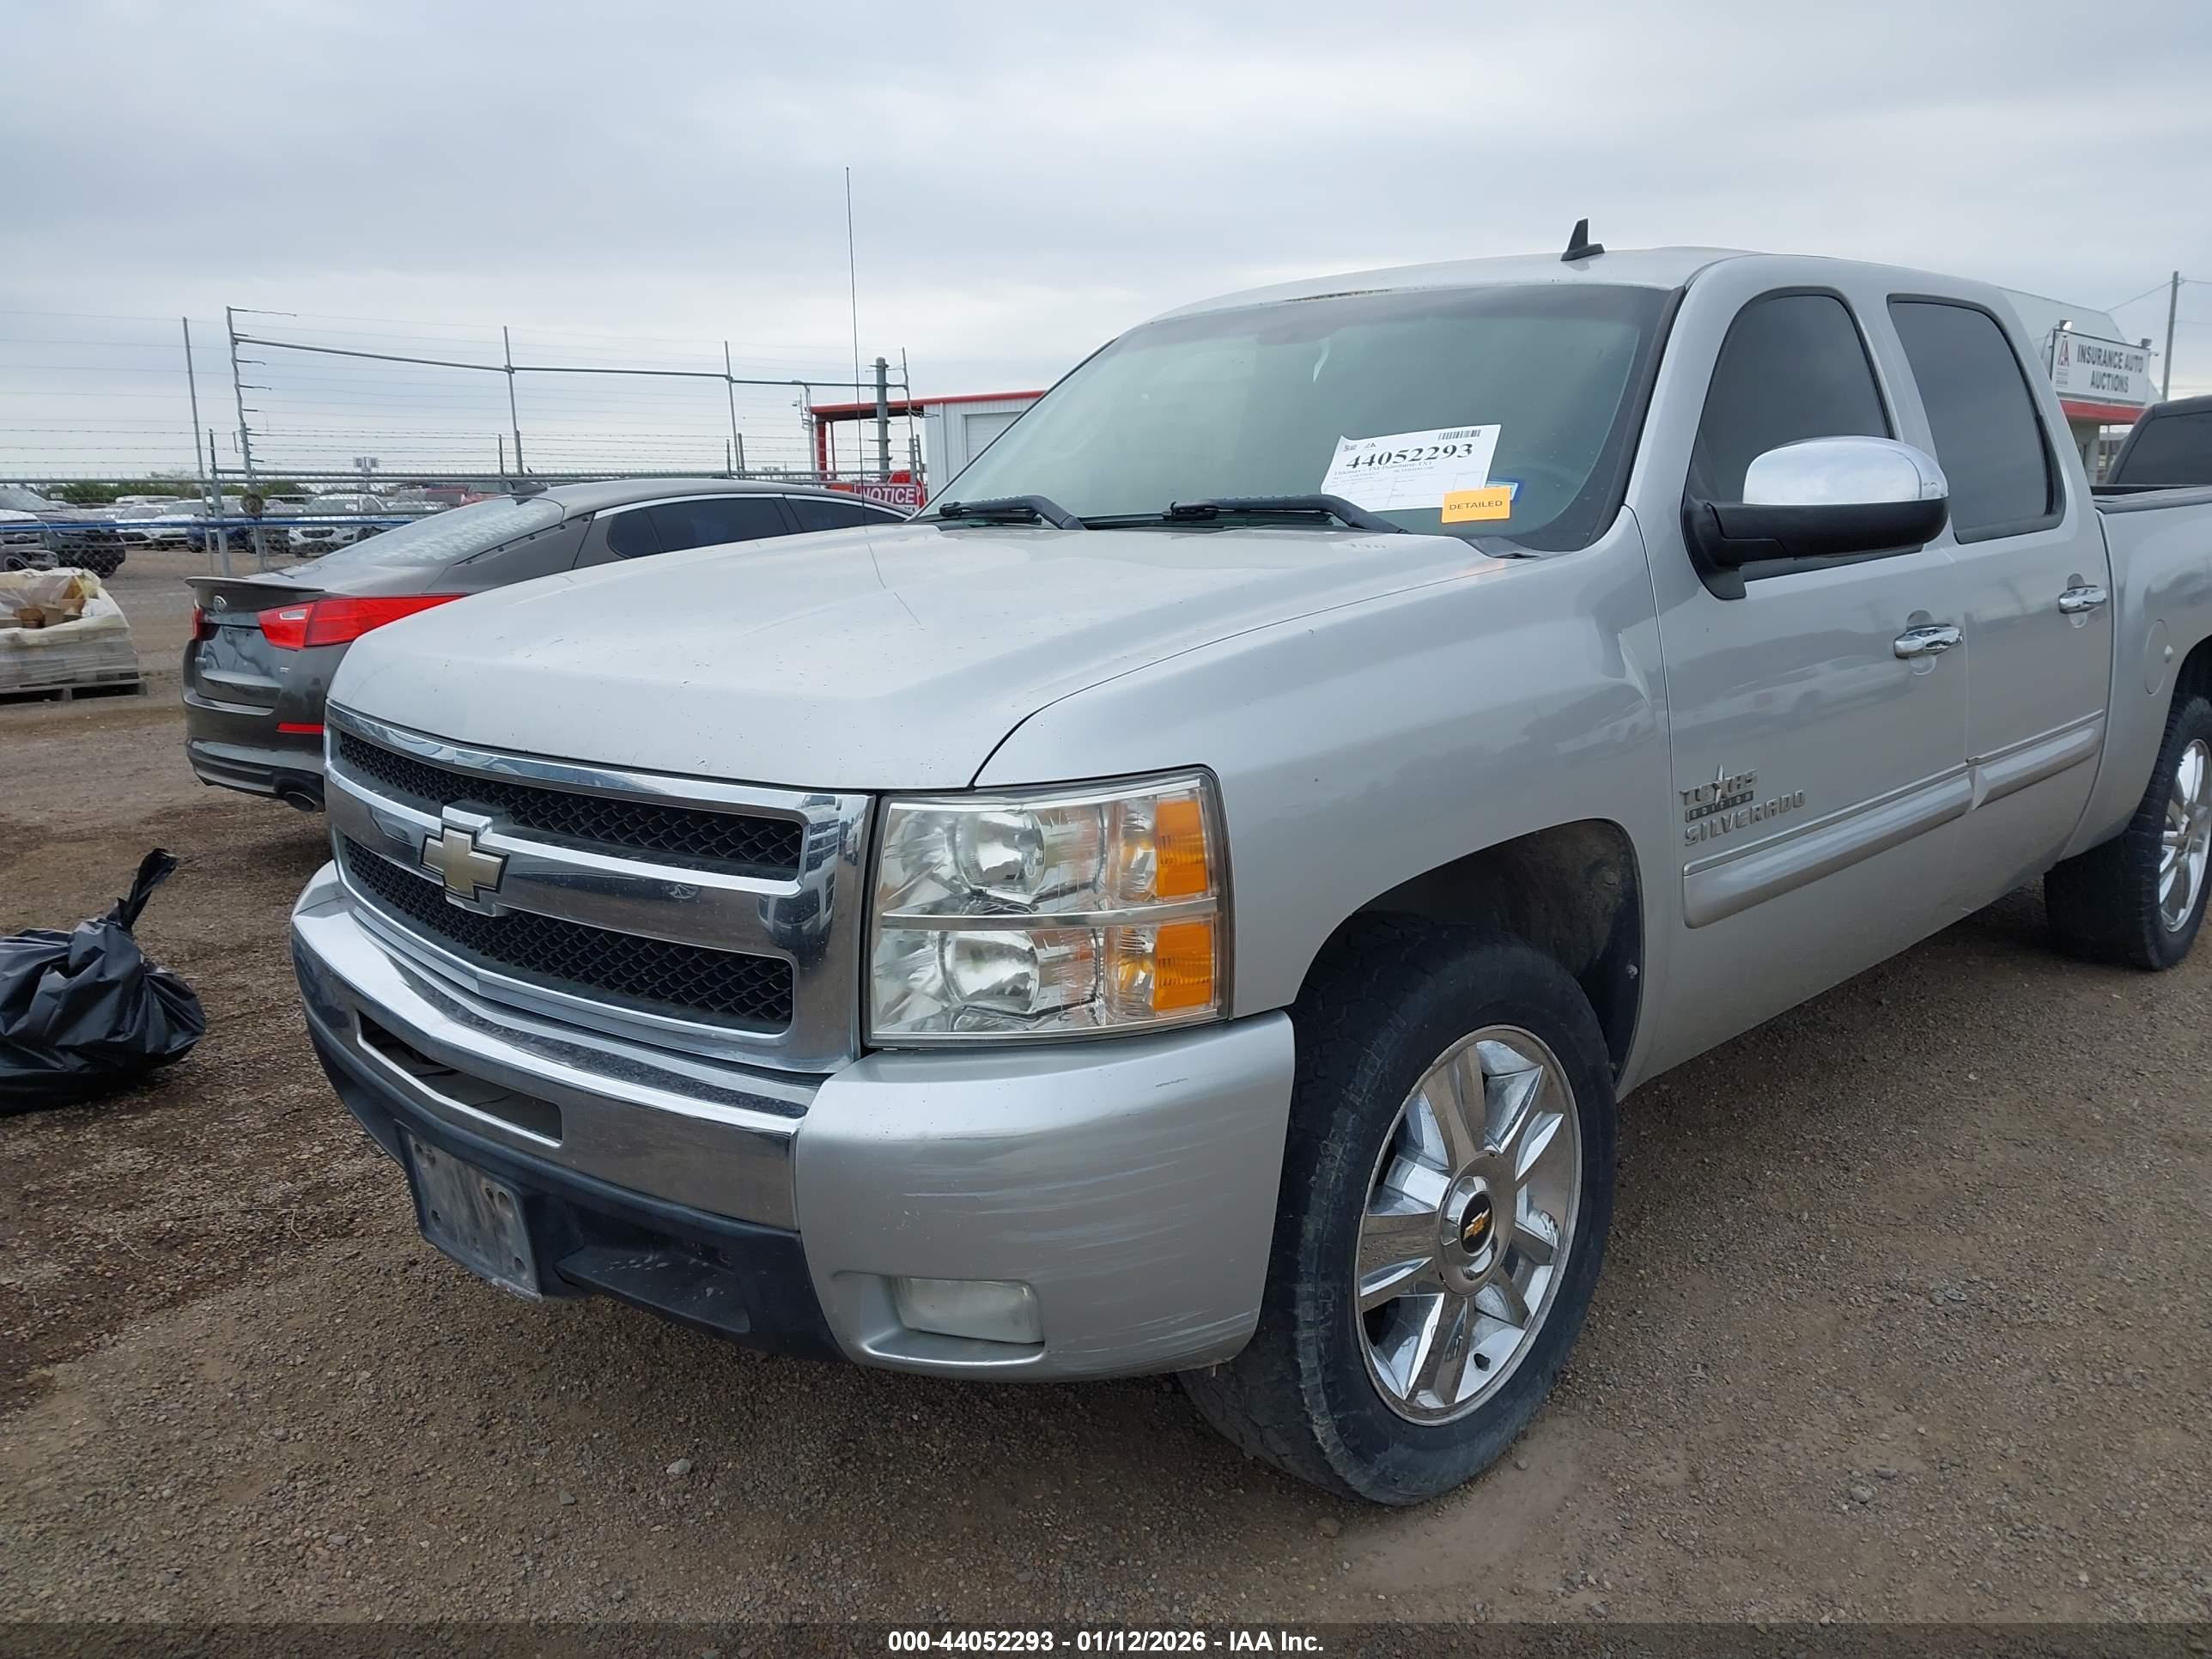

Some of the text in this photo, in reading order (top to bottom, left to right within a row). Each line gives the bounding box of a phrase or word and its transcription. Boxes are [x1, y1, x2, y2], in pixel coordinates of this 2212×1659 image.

[2076, 343, 2124, 369] INSURANCE
[2124, 351, 2145, 374] AUTO
[2090, 370, 2130, 393] AUCTIONS
[1346, 443, 1474, 469] 44052293
[861, 487, 915, 504] NOTICE
[1449, 499, 1504, 511] DETAILED
[1679, 767, 1758, 806] TEXAS
[1684, 789, 1806, 848] SILVERADO
[1689, 792, 1753, 820] EDITION
